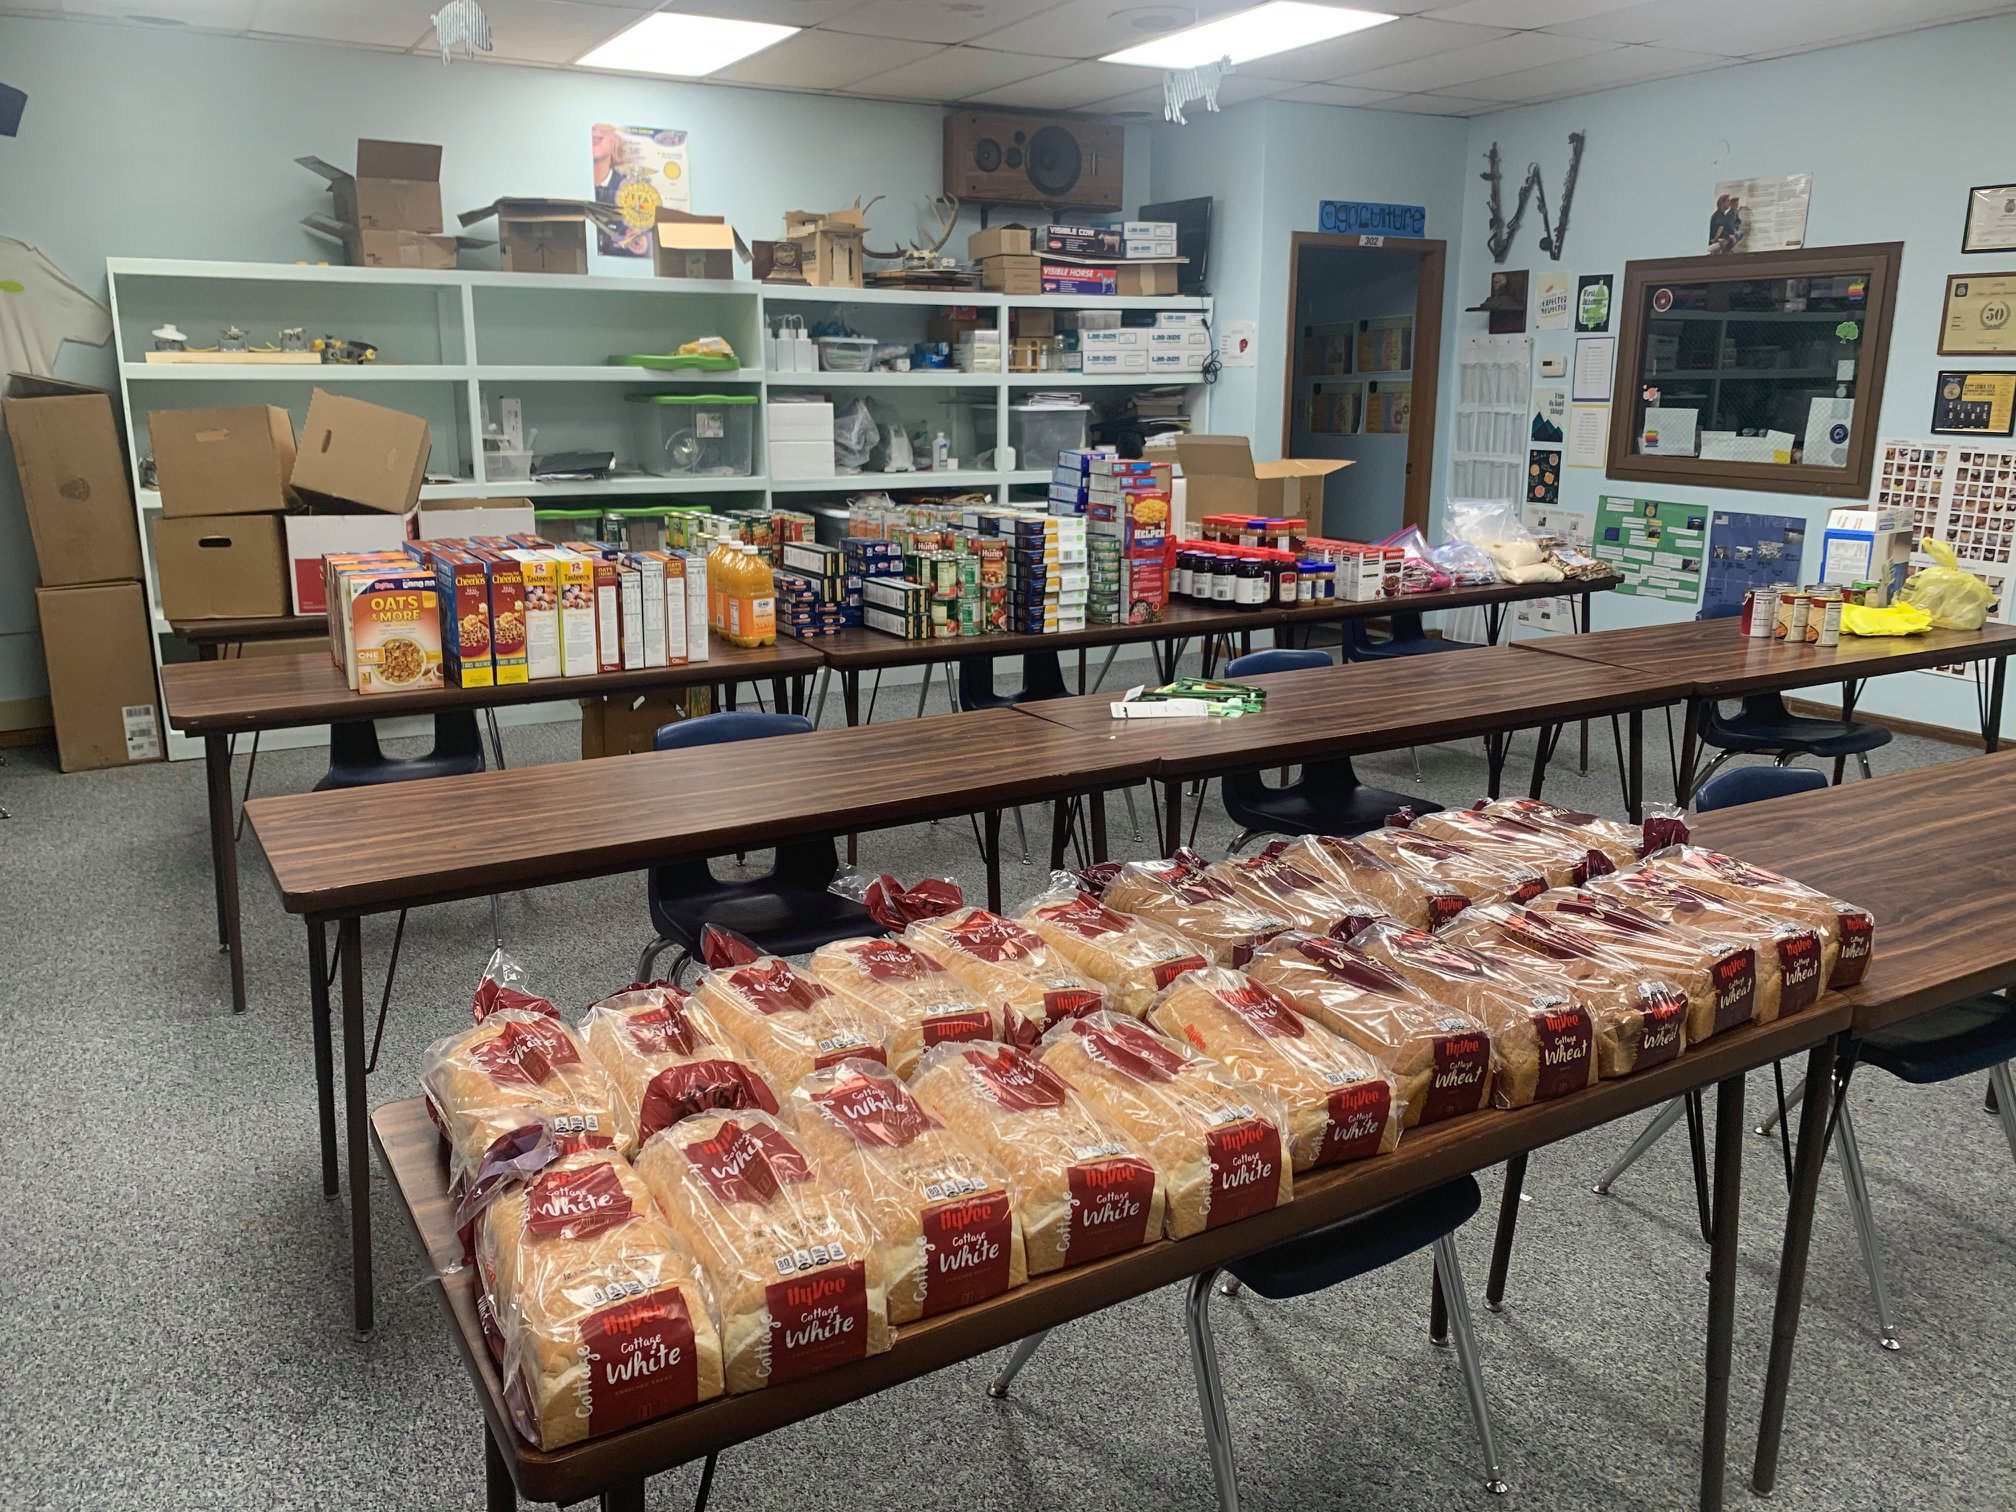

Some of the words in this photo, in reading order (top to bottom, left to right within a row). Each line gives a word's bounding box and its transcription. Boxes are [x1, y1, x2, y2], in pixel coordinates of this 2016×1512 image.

[1049, 226, 1077, 235] VISIBLE
[1078, 227, 1096, 237] COW
[1364, 237, 1379, 246] 302
[1043, 267, 1069, 276] VISIBLE
[1069, 268, 1094, 278] HORSE
[1986, 308, 2004, 321] 50
[1134, 529, 1165, 539] HELPER
[455, 576, 486, 587] Cheerios
[492, 574, 522, 585] Cheerios
[527, 575, 554, 583] Tasteeos
[564, 574, 590, 582] Tasteeos
[371, 595, 419, 611] OATS
[371, 613, 379, 621] &
[380, 610, 420, 622] MORE
[358, 651, 379, 659] ONE
[1786, 939, 1812, 957] HyVee
[1841, 941, 1870, 959] Wheat
[1720, 957, 1748, 979] HyVee
[1786, 960, 1819, 986] Wheat
[1720, 977, 1752, 1010] Wheat
[937, 1020, 979, 1038] HyVee
[1545, 1013, 1579, 1032] HyVee
[1446, 1040, 1479, 1056] HyVee
[1545, 1039, 1588, 1066] Wheat
[1435, 1066, 1483, 1088] Wheat
[1341, 1090, 1379, 1110] HyVee
[1348, 1112, 1373, 1123] Cottage
[1222, 1127, 1264, 1152] HyVee
[1334, 1120, 1378, 1141] White
[1232, 1152, 1260, 1166] Cottage
[1086, 1165, 1136, 1189] HyVee
[1222, 1160, 1272, 1190] White
[546, 1186, 588, 1200] Cottage
[1096, 1192, 1129, 1205] Cottage
[536, 1193, 614, 1217] White
[1083, 1199, 1140, 1227] White
[940, 1204, 991, 1231] HyVee
[1056, 1190, 1081, 1252] Cottage
[952, 1232, 986, 1247] Cottage
[778, 1257, 791, 1269] 80
[940, 1240, 999, 1273] White
[912, 1235, 936, 1303] Cottage
[787, 1278, 846, 1306] HyVee
[603, 1303, 666, 1336] HyVee
[801, 1305, 839, 1323] Cottage
[785, 1314, 854, 1349] White
[620, 1333, 662, 1354] Cottage
[754, 1313, 781, 1378] Cottage
[606, 1344, 681, 1385] White
[573, 1345, 601, 1418] Cottage
